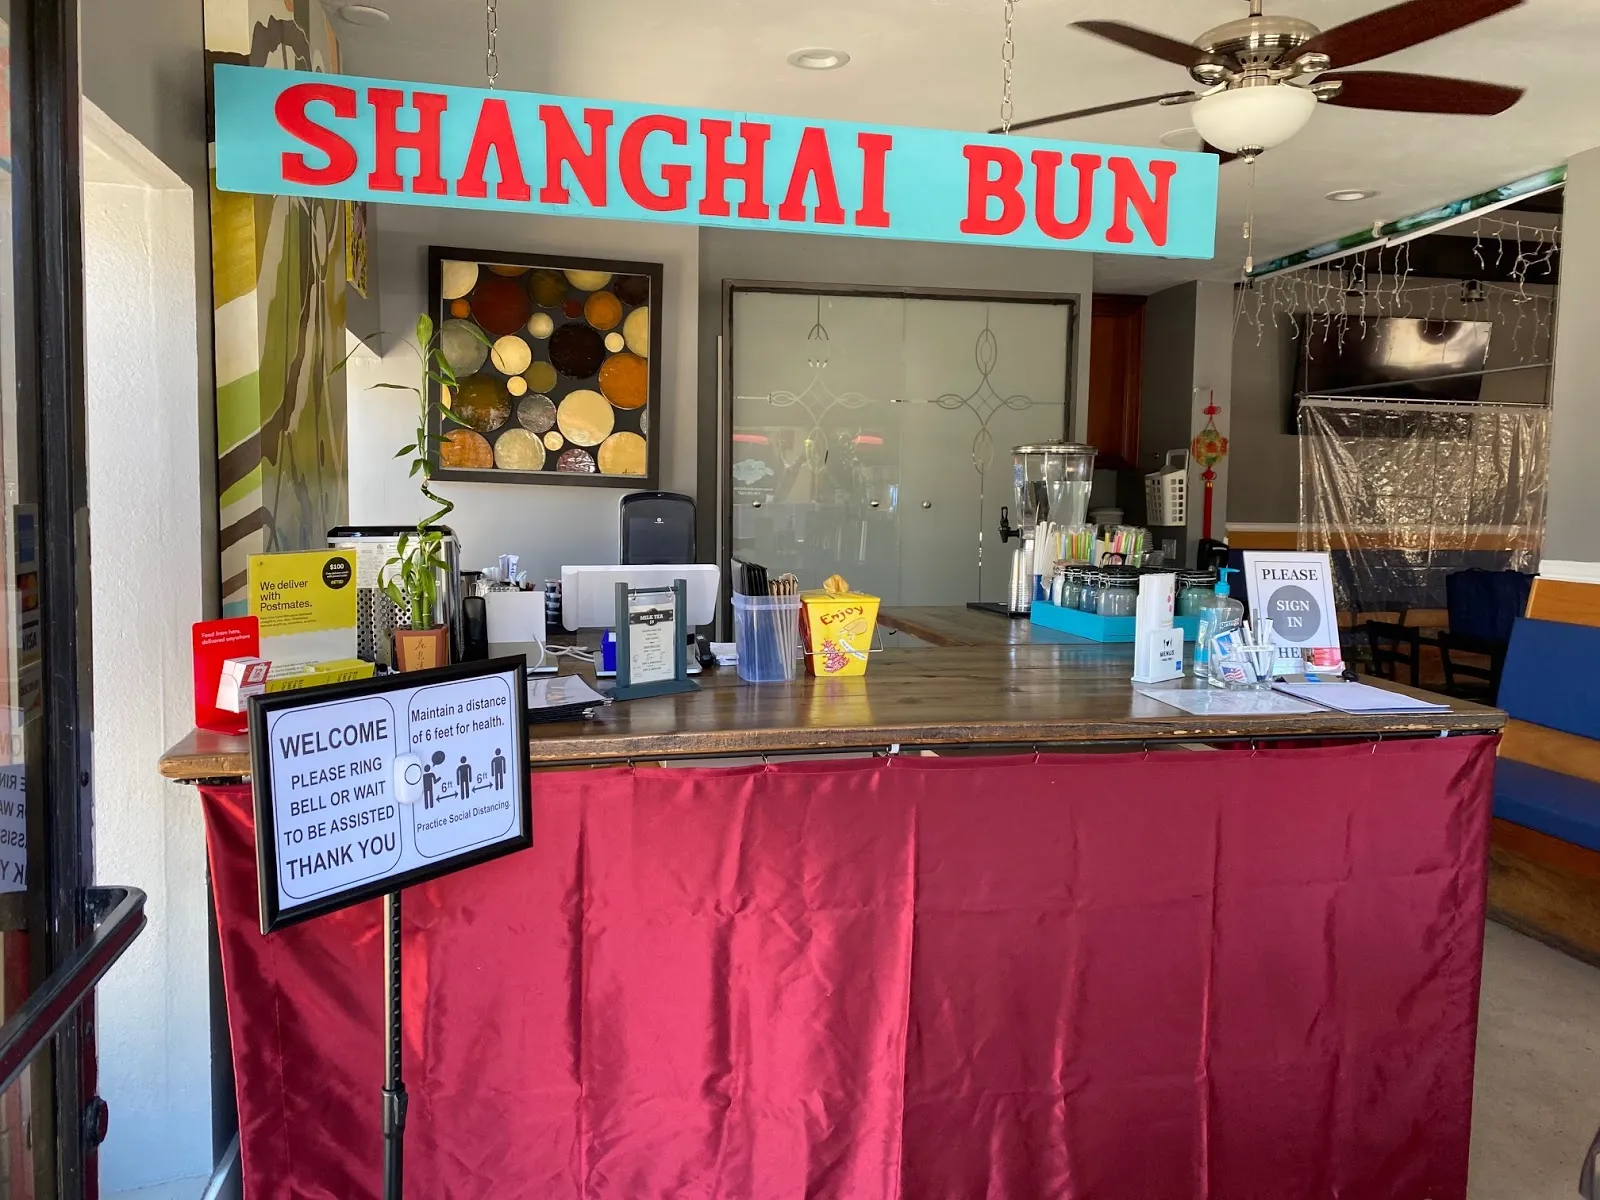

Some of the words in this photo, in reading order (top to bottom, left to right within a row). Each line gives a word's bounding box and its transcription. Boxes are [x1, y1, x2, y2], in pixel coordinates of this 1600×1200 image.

[274, 83, 893, 228] SHANGHAI
[959, 144, 1178, 247] BUN
[260, 581, 275, 591] We
[277, 580, 308, 589] deliver
[1262, 569, 1318, 580] PLEASE
[260, 592, 281, 602] with
[260, 600, 312, 612] Postmates.
[1276, 600, 1310, 611] SIGN
[820, 605, 863, 625] Enjoy
[1287, 616, 1303, 628] IN
[202, 636, 225, 646] delivered
[1278, 647, 1303, 658] HE
[411, 700, 455, 722] Maintain
[457, 703, 464, 714] a
[466, 696, 506, 712] distance
[280, 718, 388, 759] WELCOME
[412, 731, 424, 744] of
[425, 729, 432, 742] 6
[434, 724, 453, 740] feet
[455, 721, 470, 737] for
[472, 715, 505, 733] health.
[291, 764, 346, 790] PLEASE
[350, 756, 382, 777] RING
[290, 795, 326, 817] BELL
[330, 789, 350, 807] OR
[353, 780, 386, 802] WAIT
[284, 828, 303, 846] TO
[308, 821, 327, 840] BE
[330, 804, 395, 835] ASSISTED
[417, 816, 448, 833] Practice
[449, 808, 471, 824] Social
[472, 799, 511, 818] Distancing.
[286, 843, 354, 880] THANK
[357, 832, 397, 857] YOU
